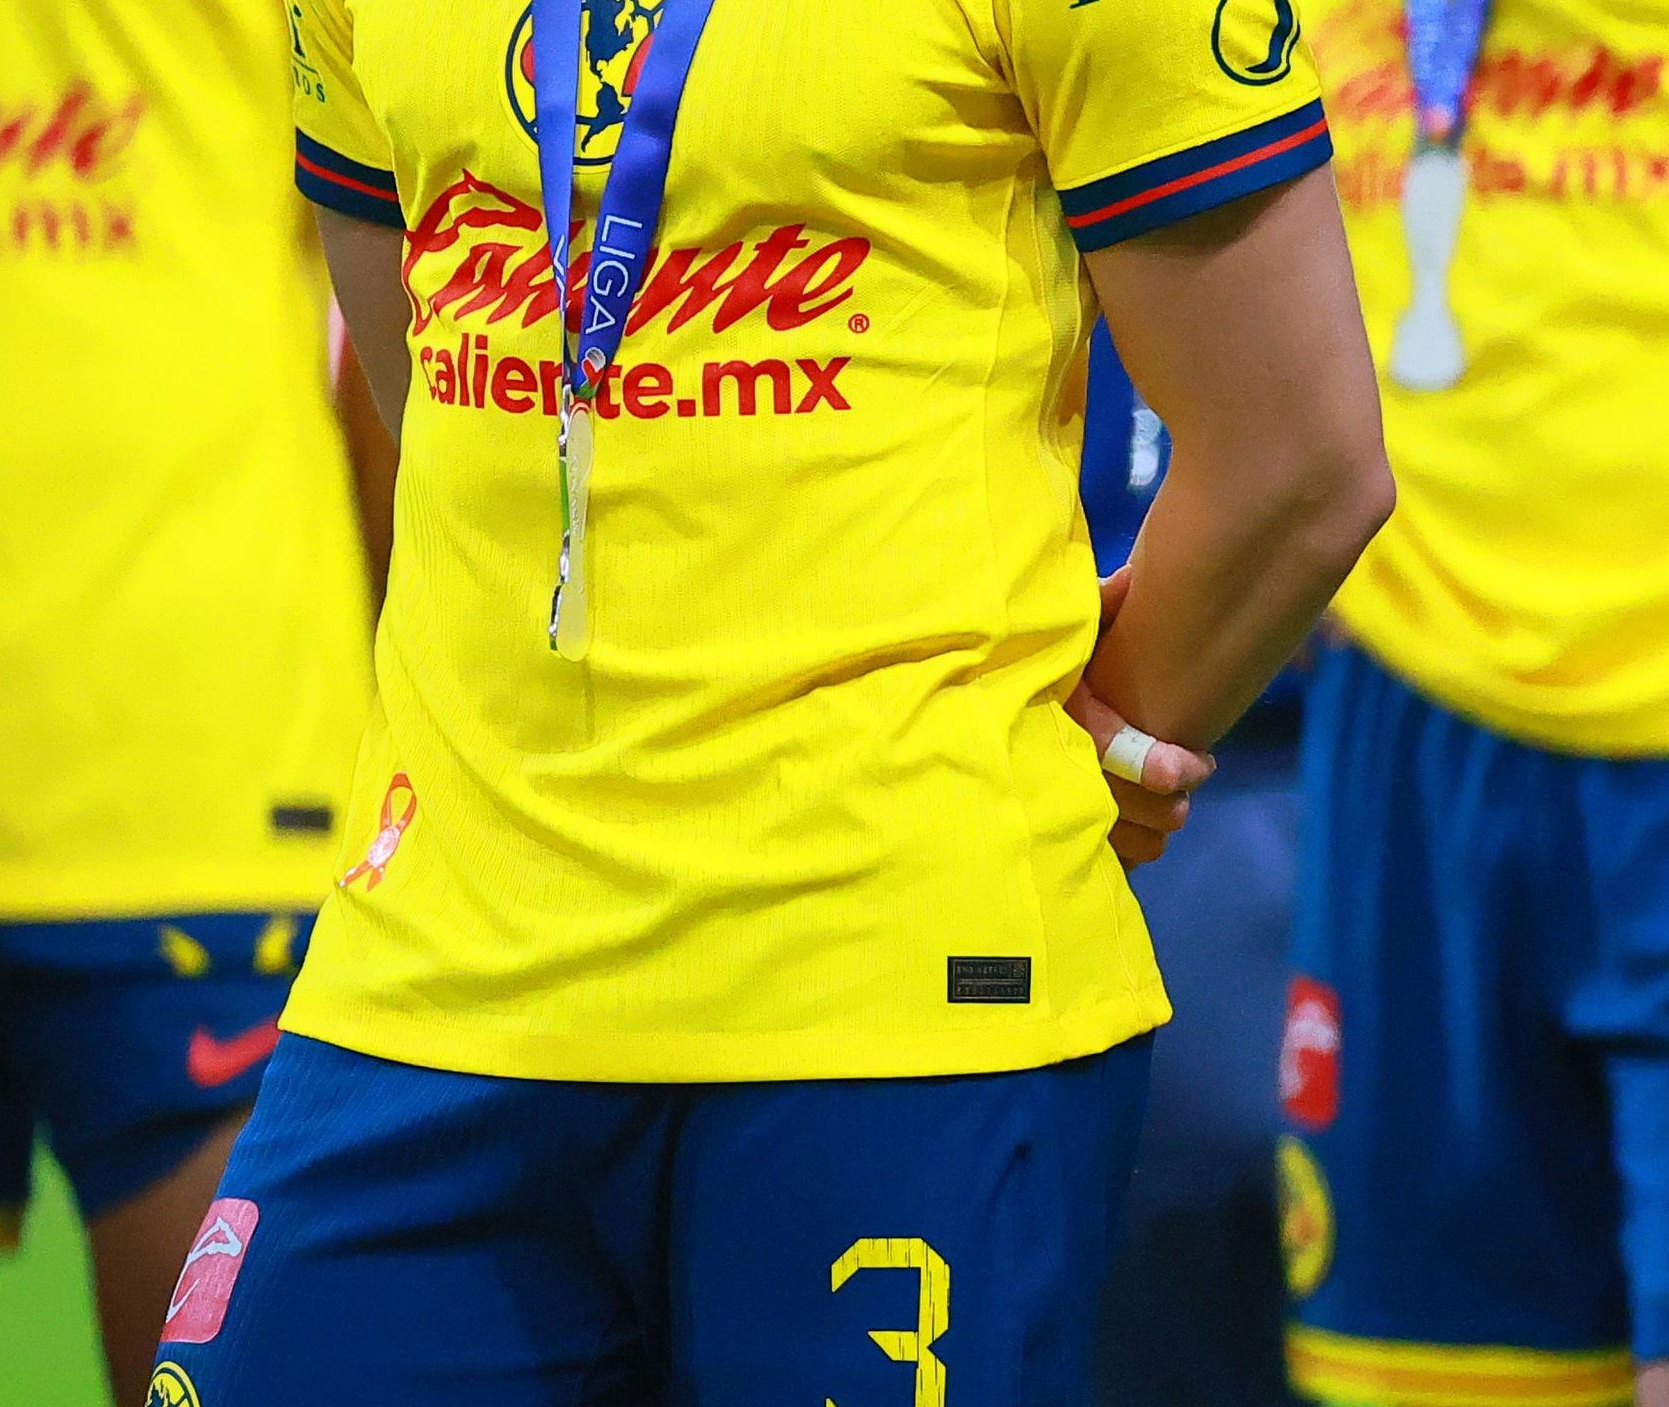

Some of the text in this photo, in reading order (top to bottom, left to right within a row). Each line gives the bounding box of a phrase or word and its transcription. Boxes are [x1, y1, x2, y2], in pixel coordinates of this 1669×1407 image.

[403, 168, 872, 337] Calnte
[585, 214, 643, 335] LIGA
[826, 1236, 952, 1407] 3
